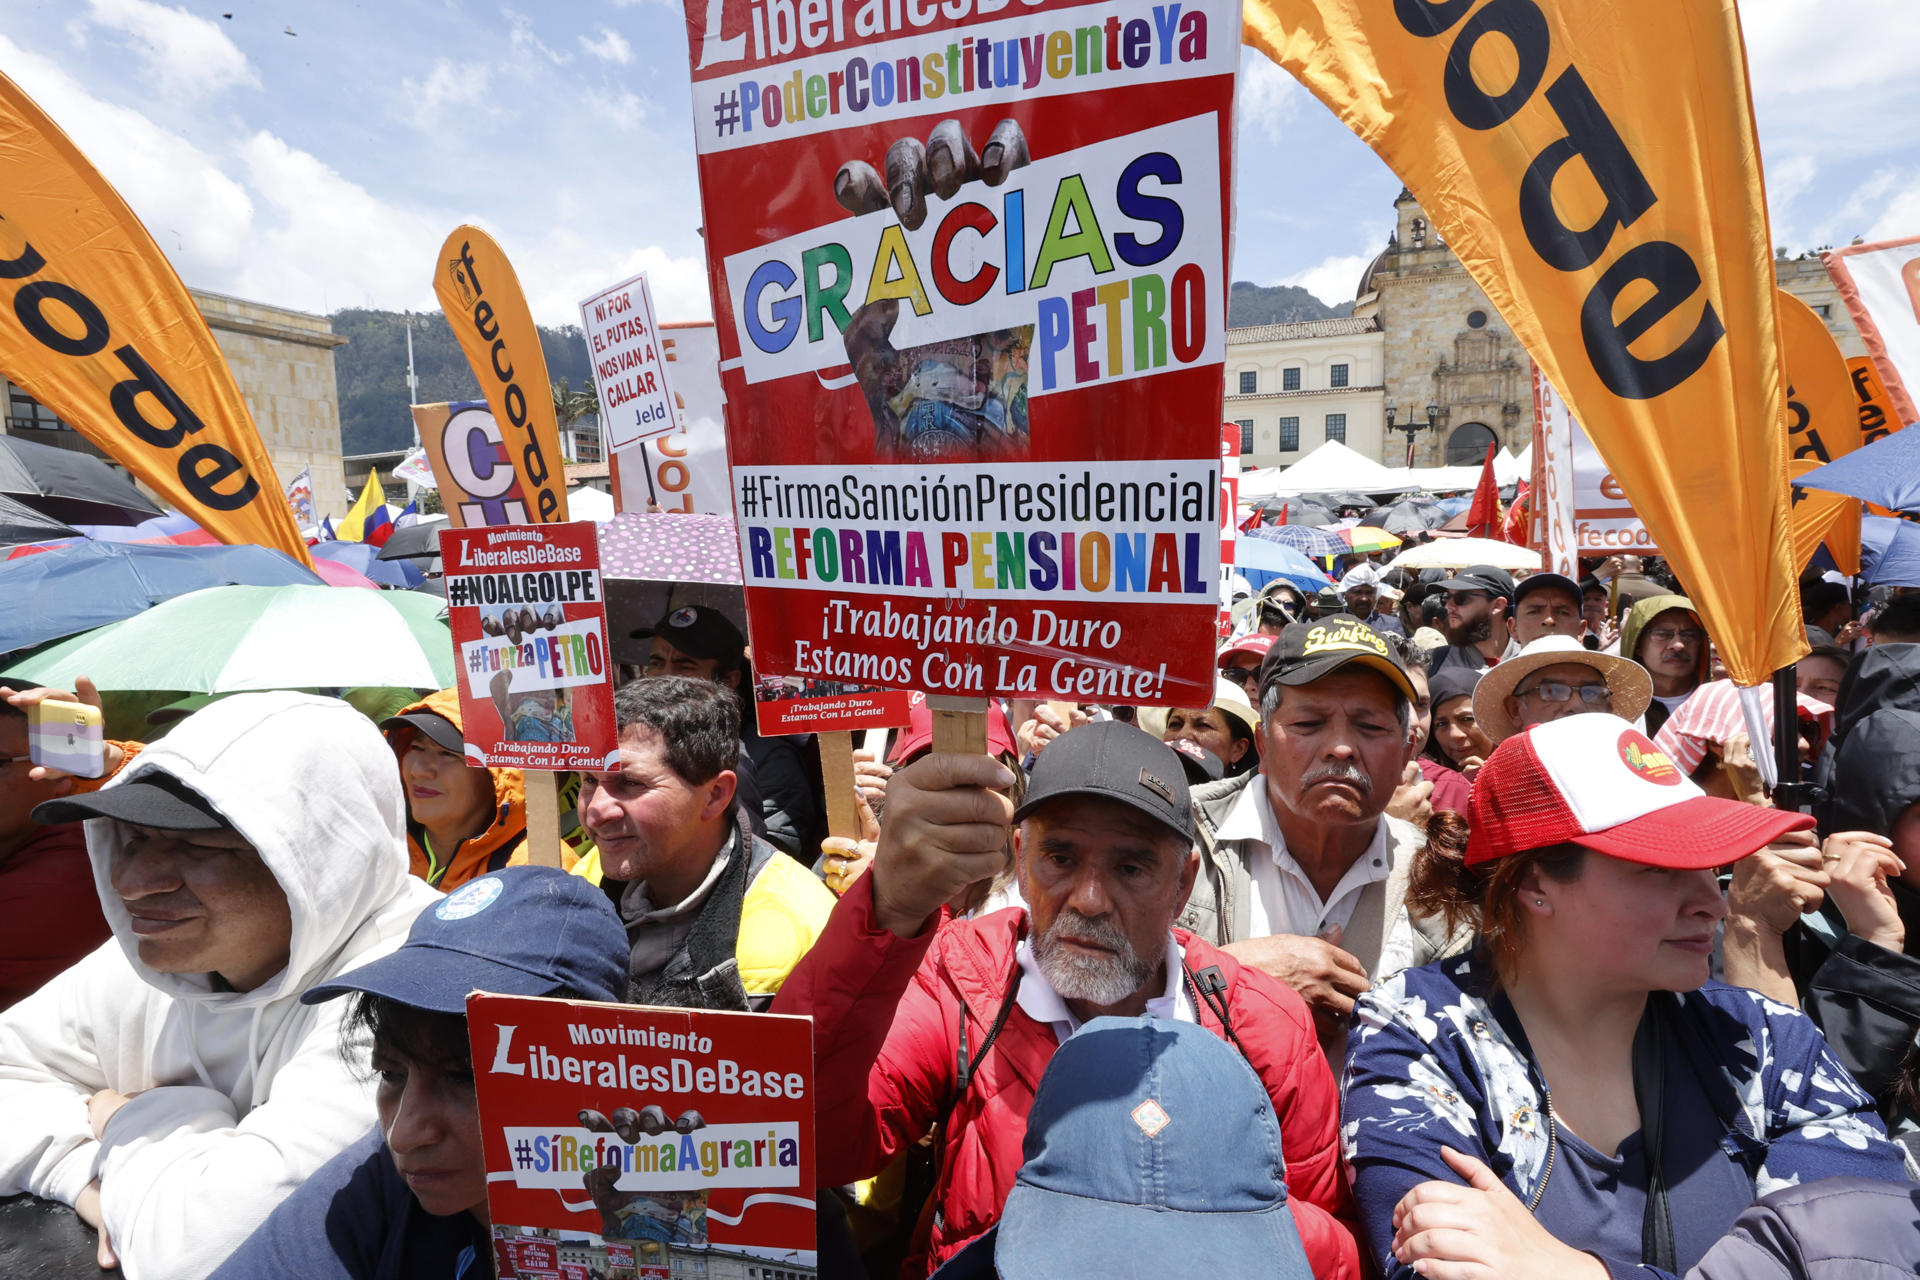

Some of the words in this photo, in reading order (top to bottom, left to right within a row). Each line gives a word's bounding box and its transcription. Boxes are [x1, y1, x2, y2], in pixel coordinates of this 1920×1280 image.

[695, 0, 1044, 70] Liberales
[713, 3, 1208, 137] #PoderConstituyenteYa
[743, 151, 1185, 354] GRACIAS
[595, 303, 607, 324] NI
[608, 291, 632, 318] POR
[1038, 262, 1207, 391] PETRO
[593, 334, 607, 354] EL
[606, 315, 648, 348] PUTAS,
[646, 343, 655, 363] A
[607, 370, 658, 409] CALLAR
[635, 401, 666, 426] Jeld
[741, 469, 1216, 523] #FirmaSanciónPresidencial
[459, 539, 582, 568] LiberalesDeBase
[487, 529, 544, 545] Movimiento
[749, 526, 933, 588] REFORMA
[941, 531, 1207, 594] PENSIONAL
[449, 571, 596, 607] #NOALGOLPE
[822, 599, 1019, 648] ¡Trabajando
[1029, 608, 1122, 649] Duro
[1304, 626, 1389, 656] Surfing
[469, 631, 603, 679] #FuerzaPETRO
[794, 639, 912, 684] Estamos
[922, 653, 983, 691] Con
[995, 655, 1038, 692] La
[1050, 657, 1168, 700] Gente!
[781, 712, 817, 723] Estamos
[820, 711, 838, 720] Con
[840, 709, 852, 718] La
[854, 706, 885, 717] Gente!
[848, 699, 872, 708] Duro
[484, 753, 525, 766] Estamos
[527, 755, 548, 766] Con
[551, 755, 565, 767] La
[568, 757, 605, 768] Gente!
[493, 741, 558, 755] ¡Trabajando
[561, 743, 590, 755] Duro
[568, 1023, 713, 1054] Movimiento
[488, 1023, 805, 1100] LiberalesDeBase
[514, 1130, 798, 1178] #SíReformaAgraria
